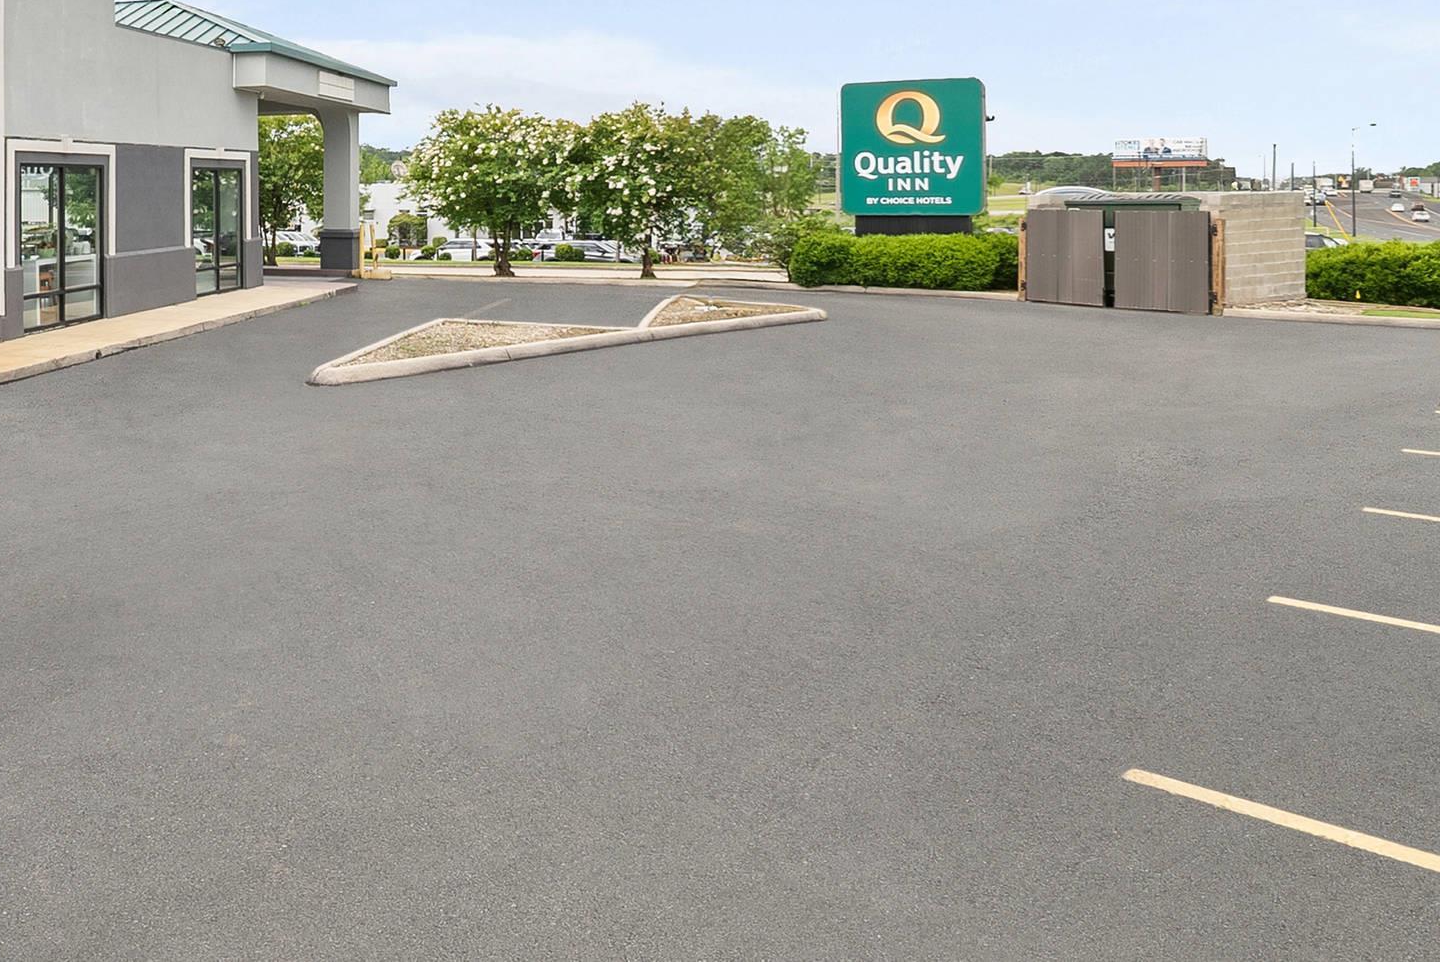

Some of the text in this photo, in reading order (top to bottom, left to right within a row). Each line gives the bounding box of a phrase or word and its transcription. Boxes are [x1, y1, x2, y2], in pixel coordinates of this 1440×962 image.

[876, 90, 946, 144] Q
[854, 150, 964, 179] Quality
[888, 177, 929, 191] INN
[866, 196, 953, 205] BY CHOICE HOTELS
